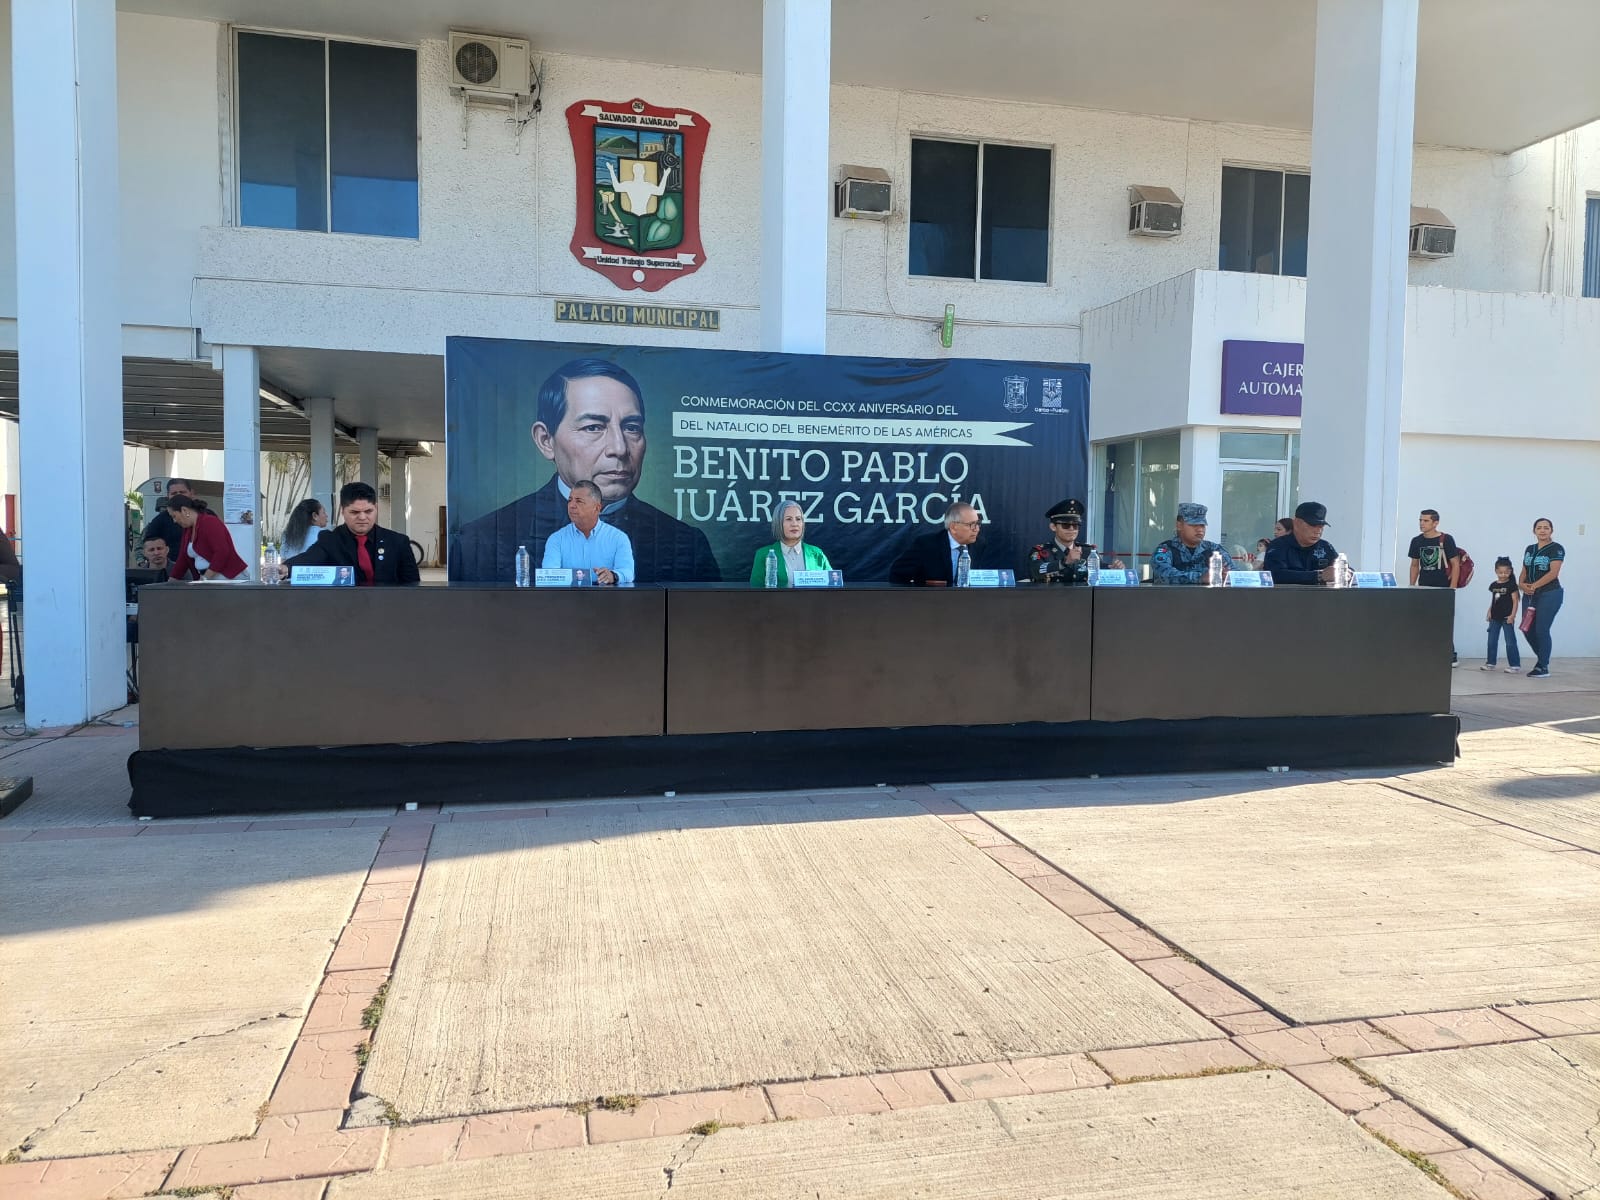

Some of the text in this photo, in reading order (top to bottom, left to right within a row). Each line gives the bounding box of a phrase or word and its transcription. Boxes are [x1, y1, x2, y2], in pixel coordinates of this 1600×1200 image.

[598, 113, 678, 127] SALVADOR ALVARADO
[597, 256, 620, 265] Unidad
[621, 257, 645, 267] Trabajo
[557, 301, 719, 329] PALACIO MUNICIPAL
[680, 395, 958, 415] CONMEMORACIÓN DEL CCXX ANIVERSARIO DEL
[680, 419, 973, 438] DEL NATALICIO DEL BENEMÉRITO DE LAS AMÉRICAS
[673, 445, 969, 484] BENITO PABLO
